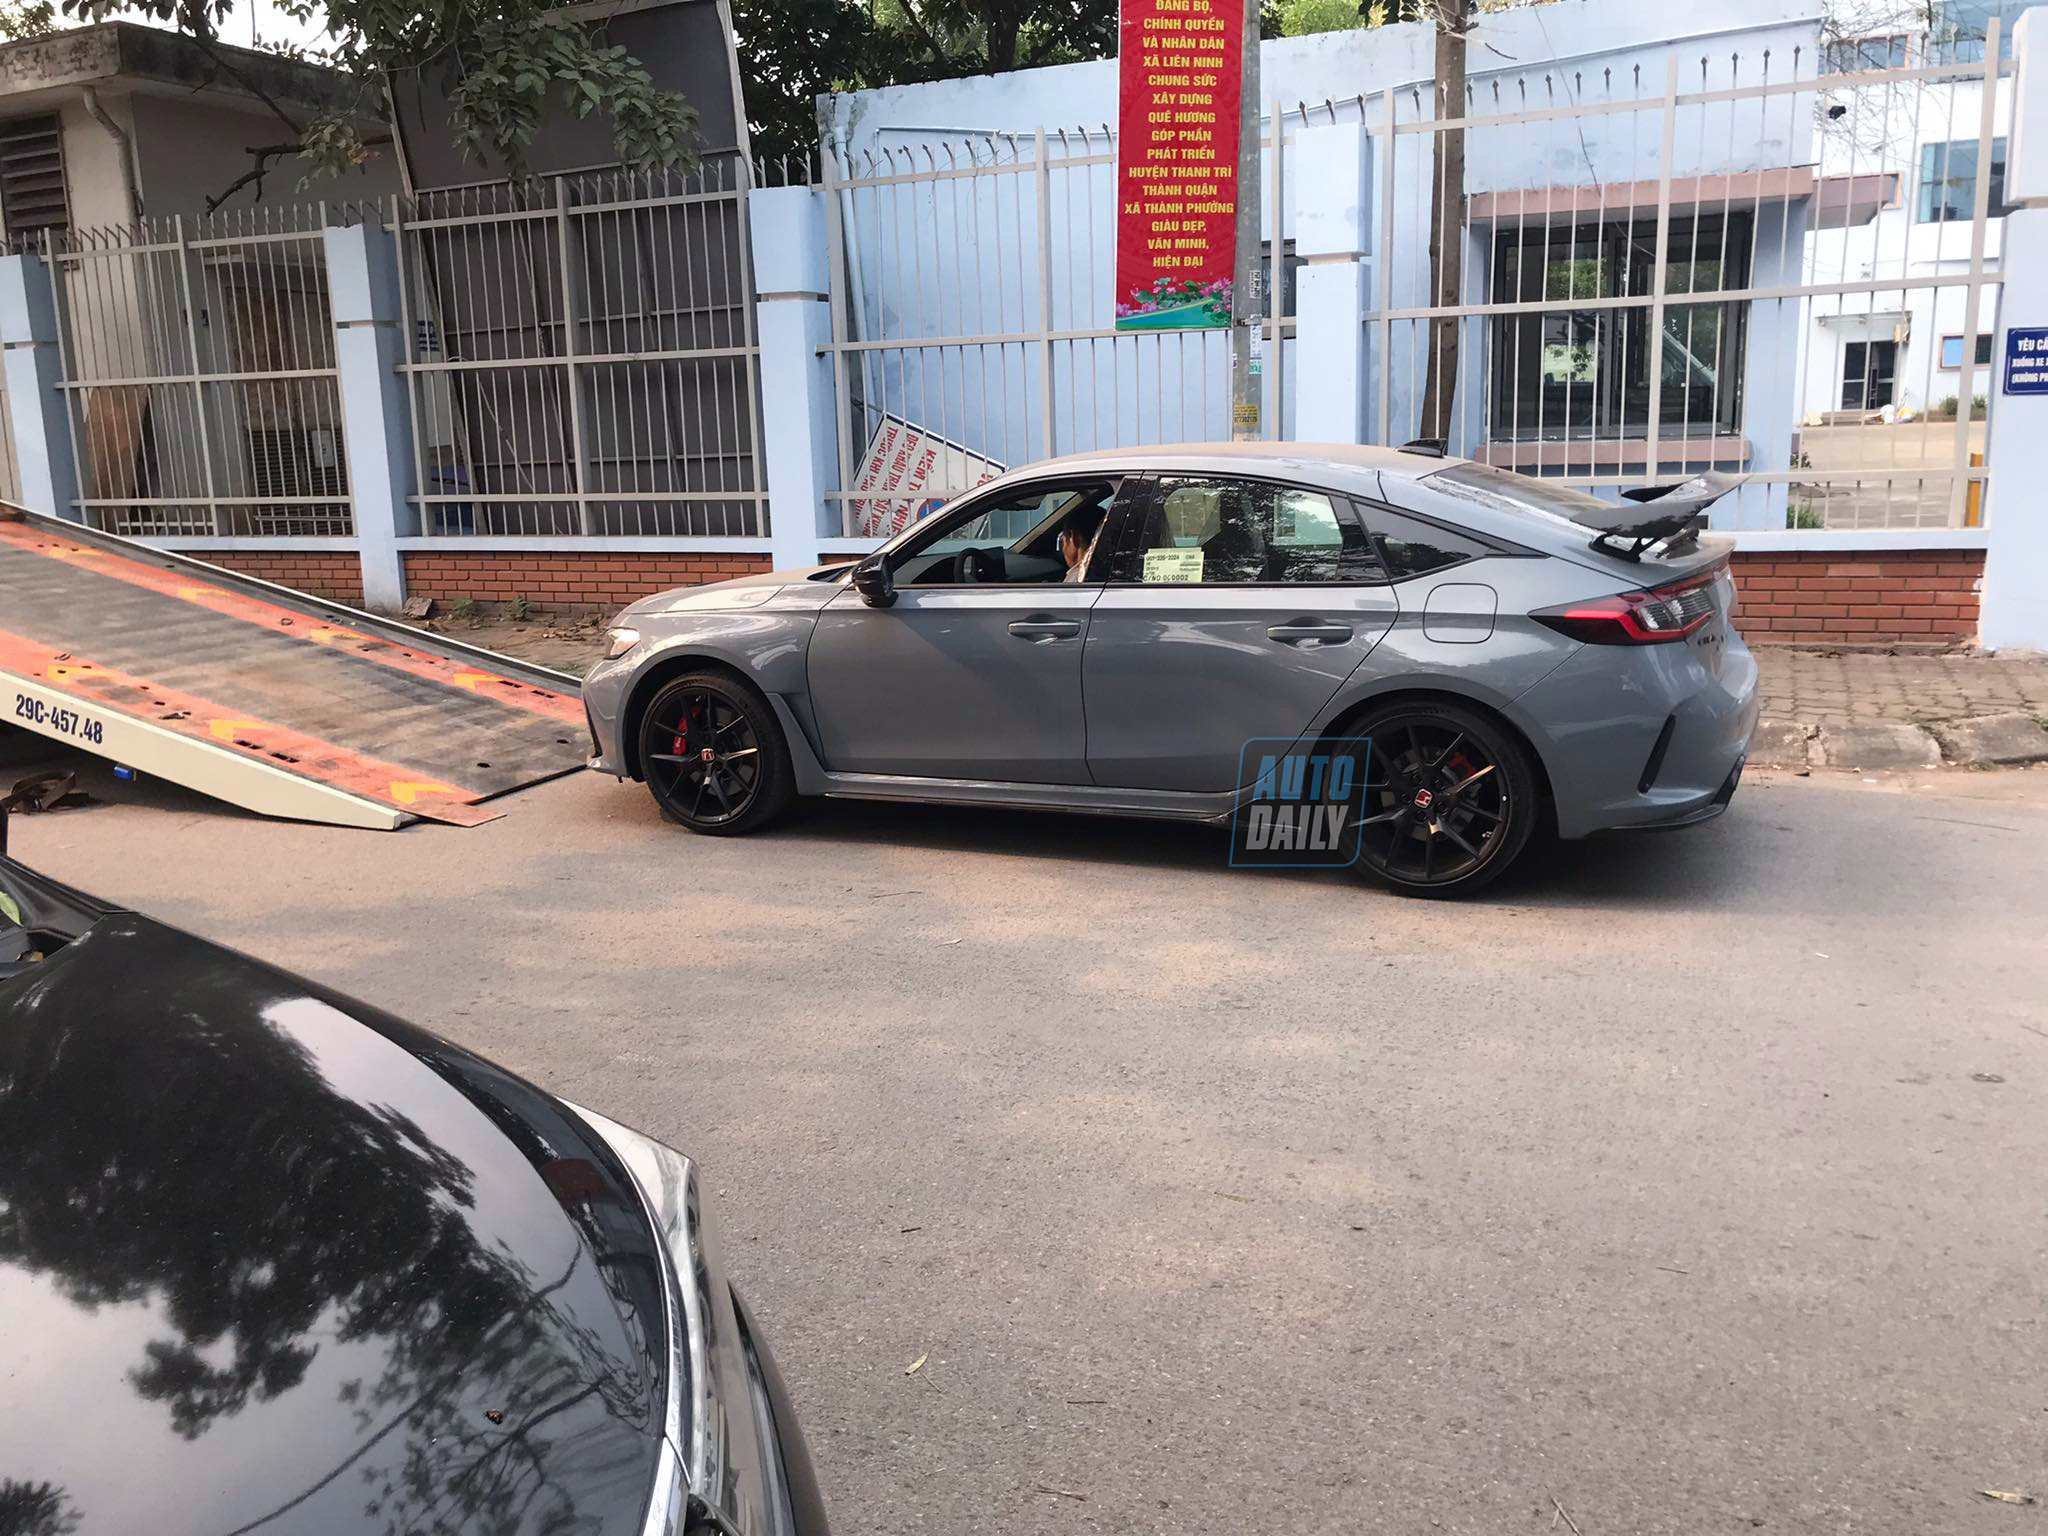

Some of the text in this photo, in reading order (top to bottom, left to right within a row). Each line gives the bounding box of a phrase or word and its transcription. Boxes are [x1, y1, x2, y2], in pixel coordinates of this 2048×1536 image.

[1143, 16, 1181, 30] CHÍNH
[1143, 34, 1225, 50] VÀ NHÂN DÂN
[1143, 54, 1223, 68] XÃ LIÊN NINH
[1148, 73, 1217, 87] CHUNG SỨC
[1152, 92, 1213, 107] XÂY DỰNG
[1148, 111, 1216, 123] QUÊ HƯƠNG
[1151, 128, 1175, 141] GÓP
[1147, 144, 1215, 160] PHÁT TRIỂN
[1129, 165, 1232, 180] HUYỆN THANH TRÌ
[1142, 183, 1217, 198] THÀNH QUẬN
[1125, 201, 1234, 214] XÃ THÀNH PHƯỜNG
[1151, 219, 1179, 232] GIÀU
[1147, 238, 1209, 250] VĂN MINH,
[1153, 255, 1203, 269] HIỆN ĐẠI
[2017, 337, 2035, 351] YÊU
[870, 456, 885, 474] KHI
[16, 693, 103, 744] 29C-457.48
